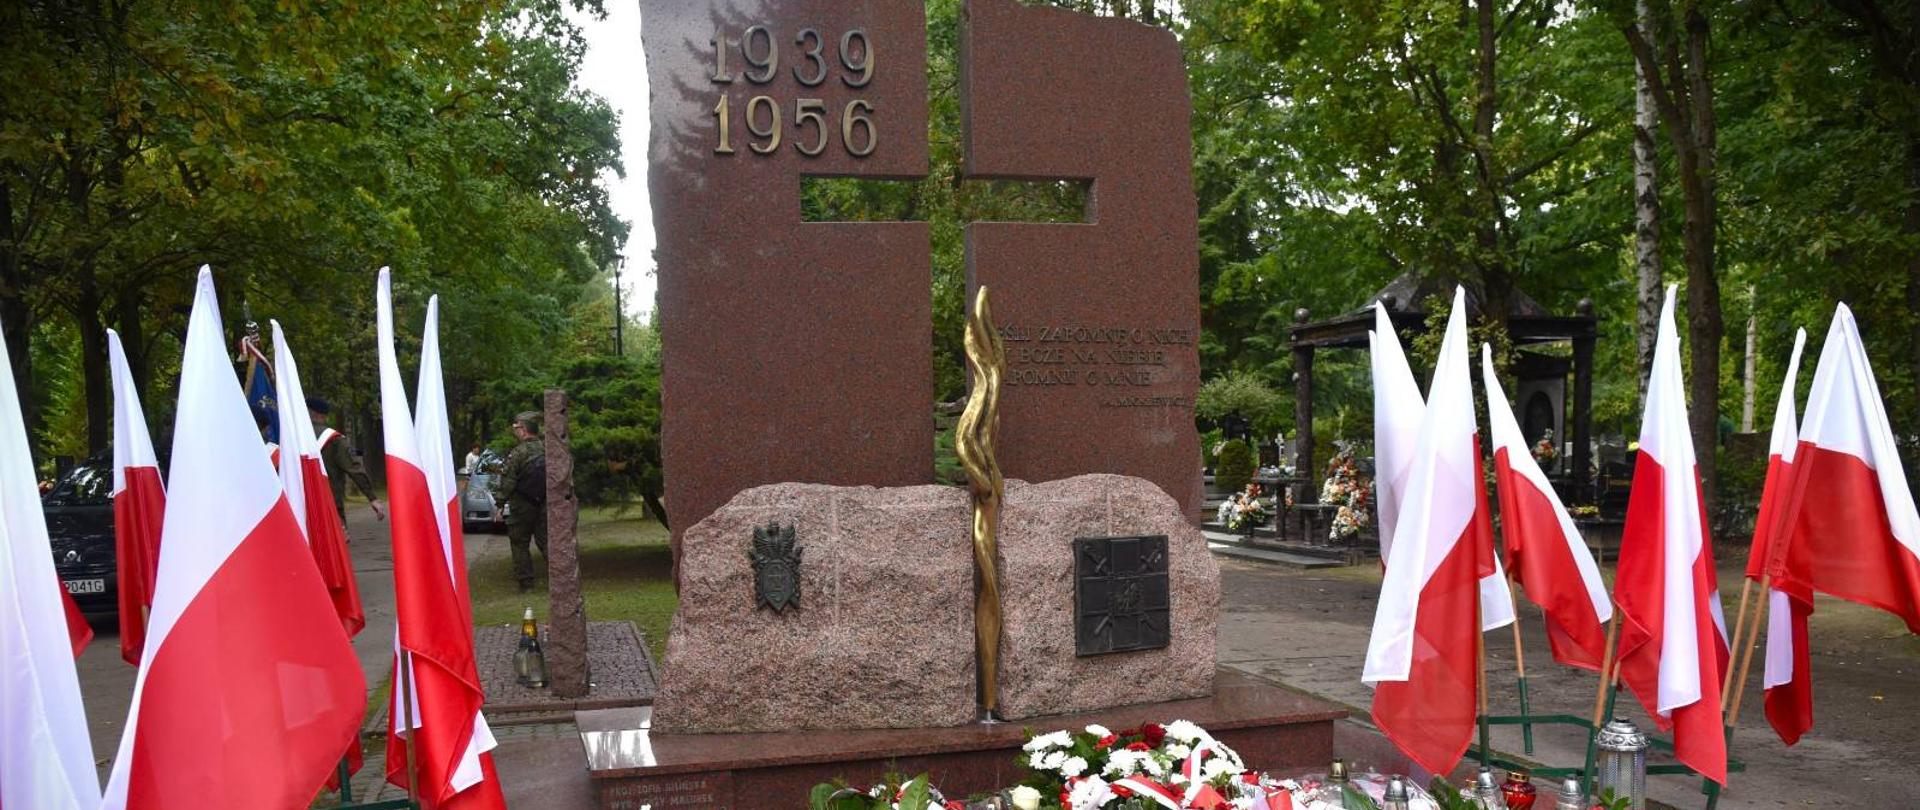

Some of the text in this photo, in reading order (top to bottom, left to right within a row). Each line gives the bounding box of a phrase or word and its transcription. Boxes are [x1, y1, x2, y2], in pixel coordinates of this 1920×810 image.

[710, 24, 876, 88] 1939
[713, 94, 878, 157] 1956
[999, 322, 1032, 342] ŚLI
[1130, 328, 1144, 345] O
[1070, 348, 1099, 365] NA
[1004, 369, 1153, 387] POMNIJ O MNIE
